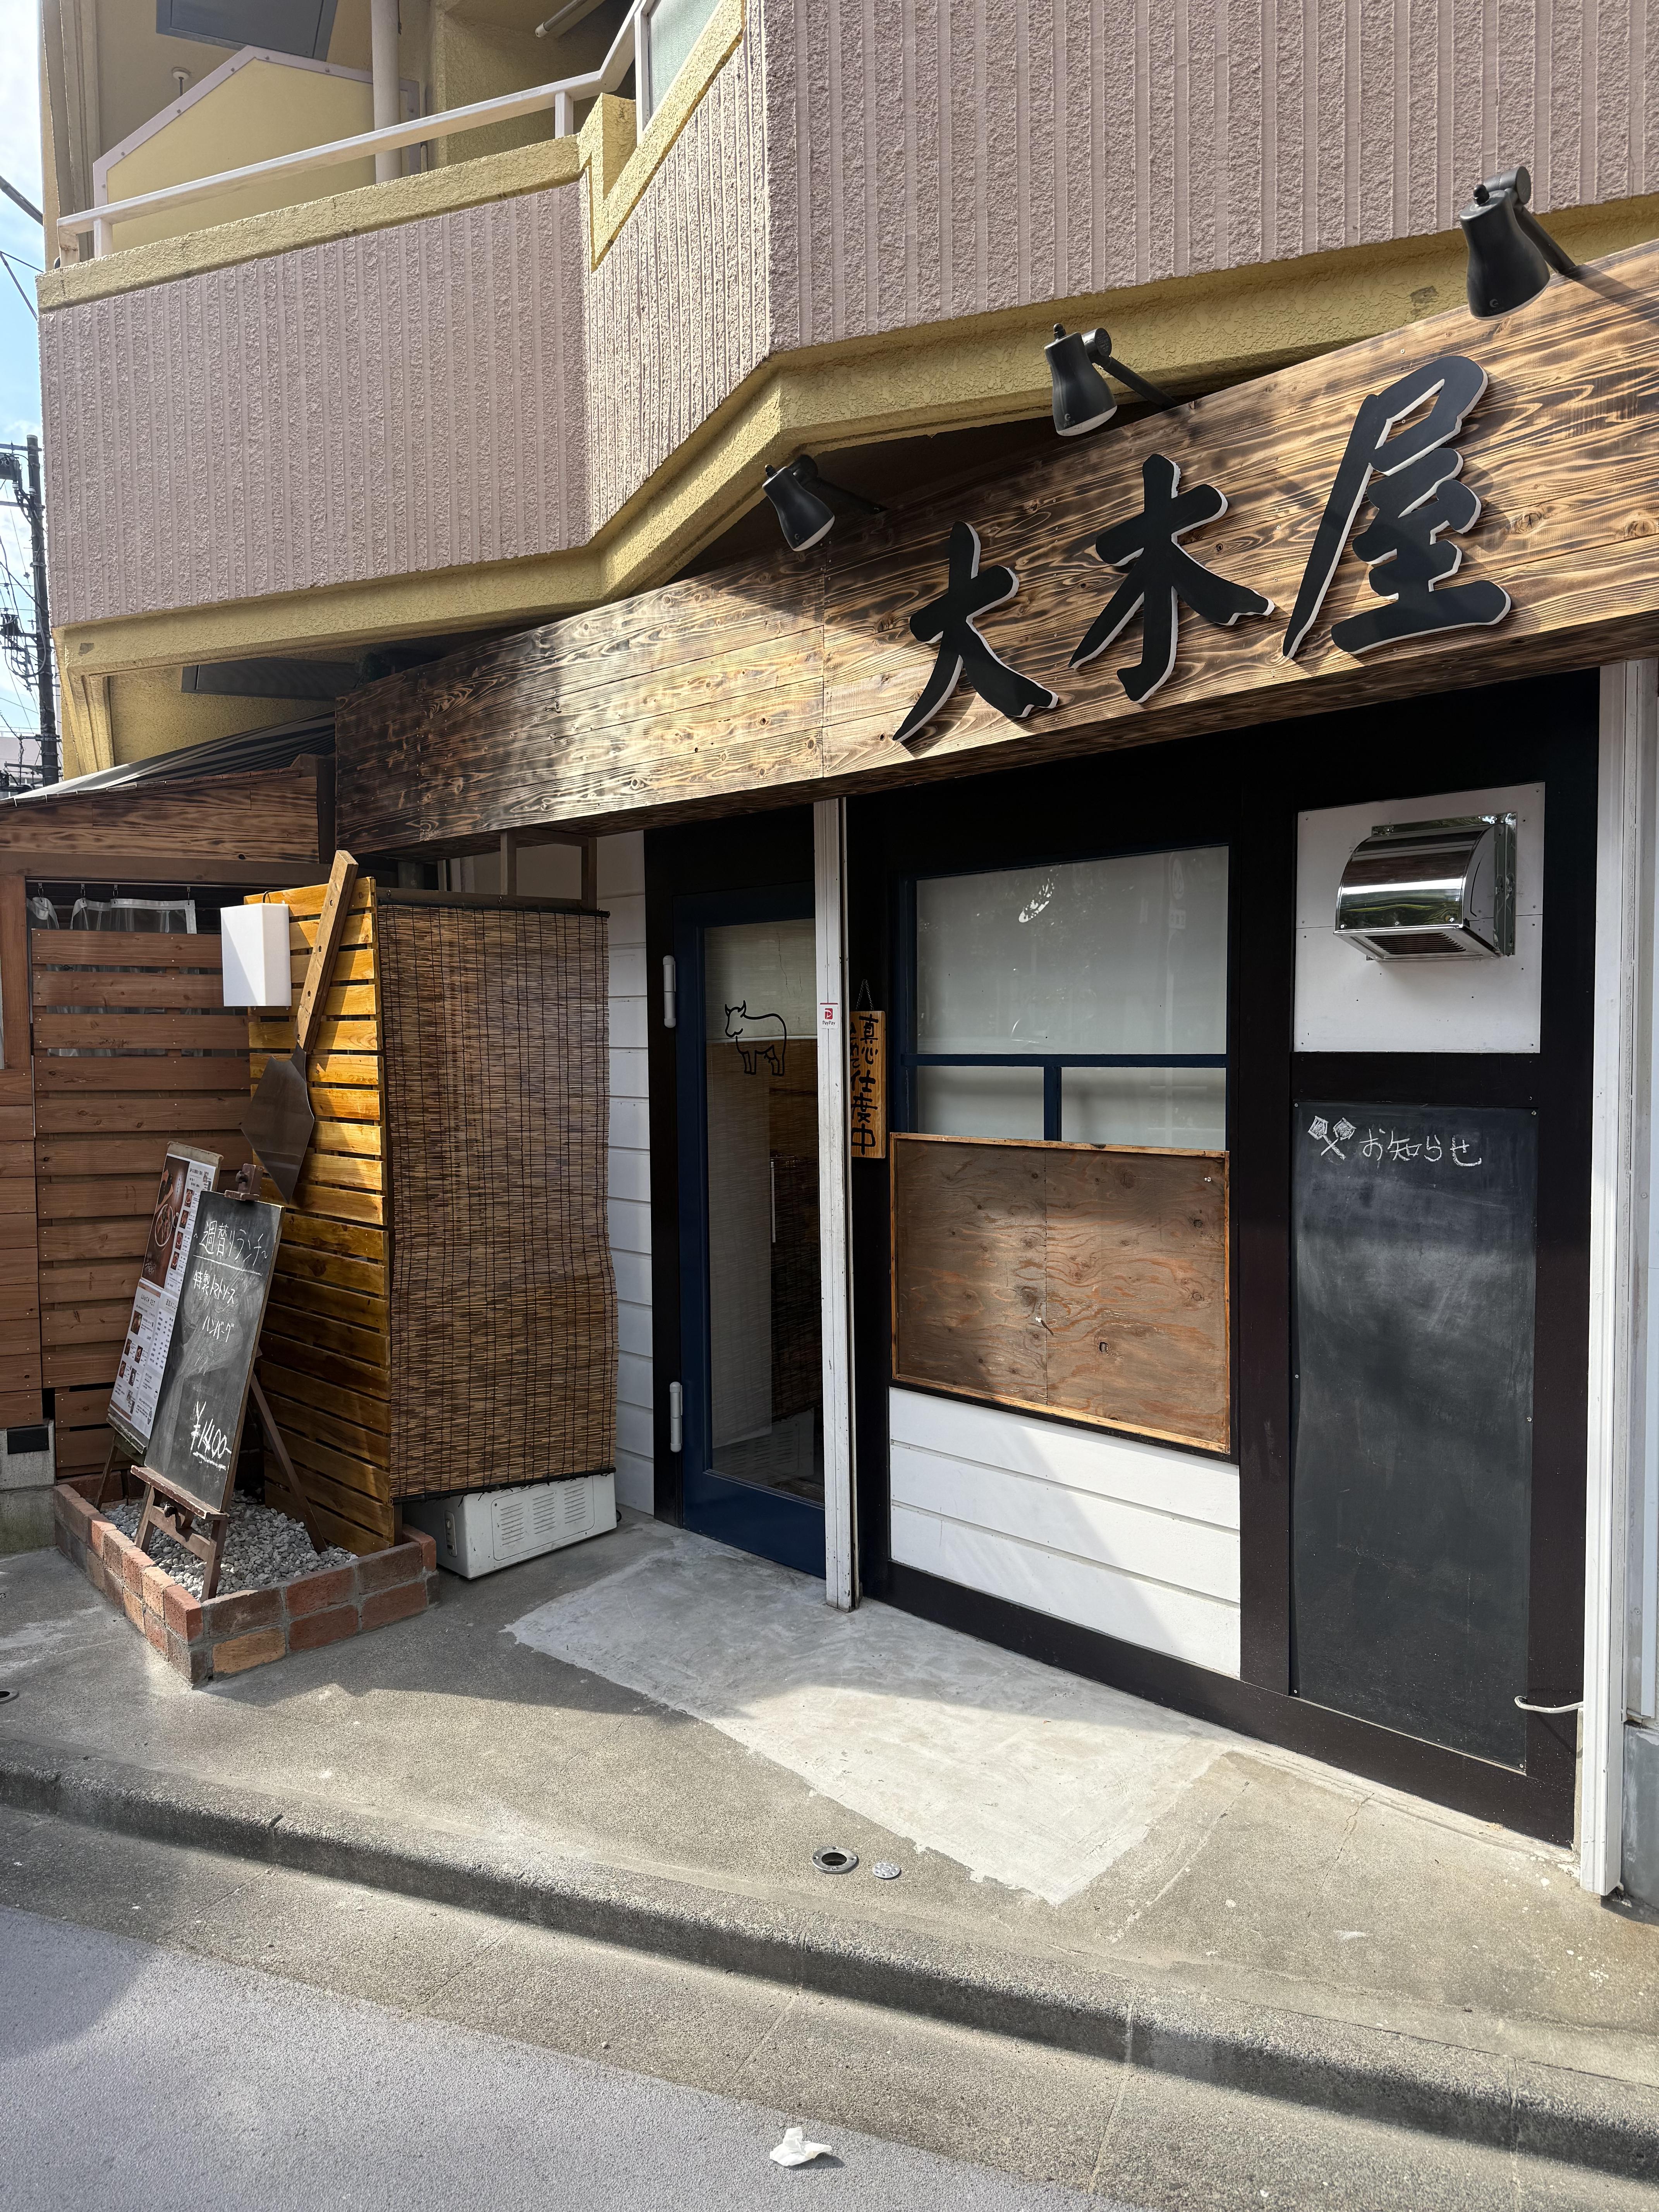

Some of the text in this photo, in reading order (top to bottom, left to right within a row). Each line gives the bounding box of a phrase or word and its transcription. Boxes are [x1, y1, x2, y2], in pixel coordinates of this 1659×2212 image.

[893, 356, 1511, 741] 大木屋
[1360, 1128, 1482, 1167] お知らせ
[193, 1270, 235, 1304] 特製トマトソース
[202, 1316, 234, 1343] ハンバーグ
